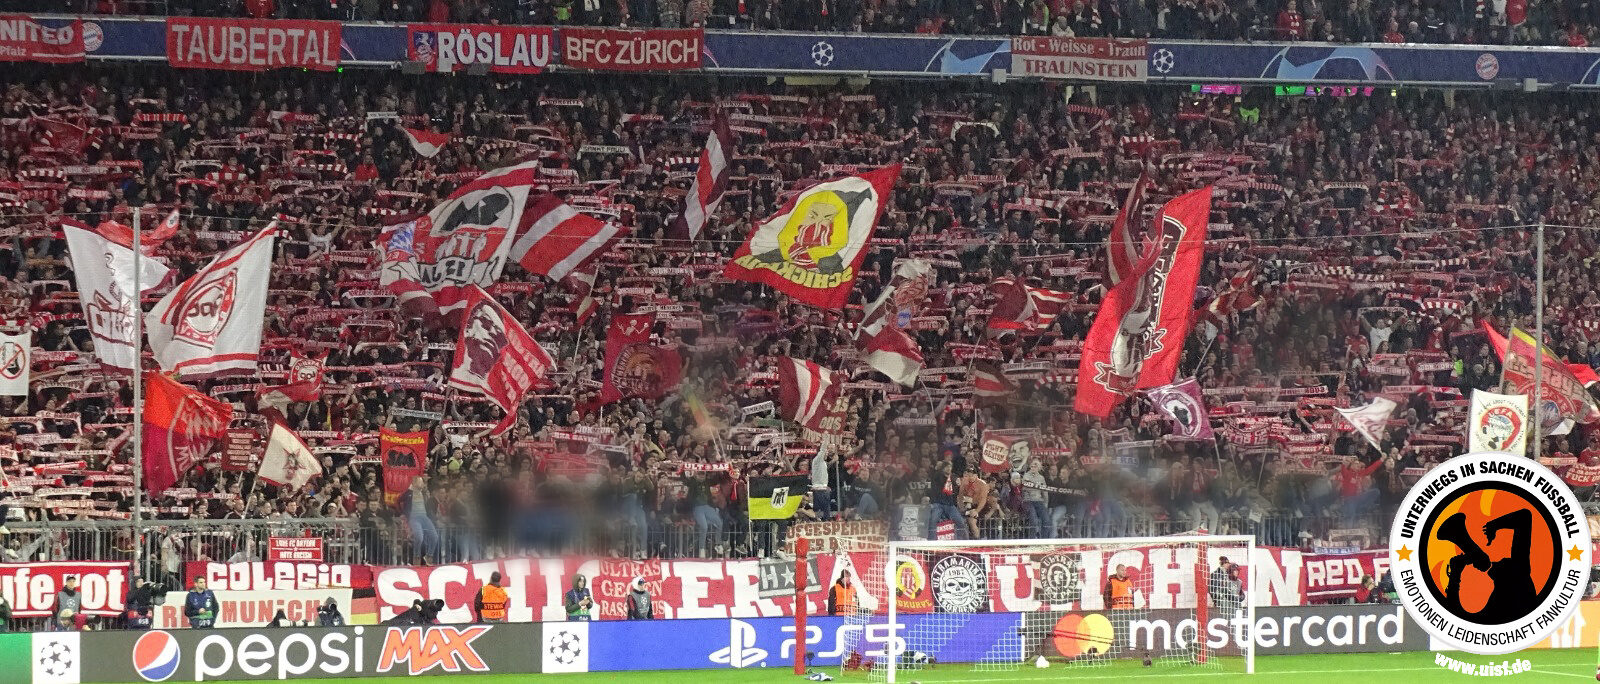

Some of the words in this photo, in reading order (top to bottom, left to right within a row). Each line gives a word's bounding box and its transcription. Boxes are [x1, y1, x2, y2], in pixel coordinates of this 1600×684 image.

[172, 25, 338, 66] TAUBERTAL
[437, 28, 549, 71] RÖSLAU
[566, 37, 611, 63] BFC
[615, 37, 699, 65] ZÜRICH
[1013, 38, 1037, 51] Rot
[1049, 39, 1095, 55] Weisse
[1023, 58, 1137, 77] TRAUNSTEIN
[600, 560, 661, 578] ULTRAS
[948, 569, 965, 577] 1987
[781, 623, 906, 659] PS5
[1130, 606, 1403, 651] mastercard
[195, 626, 364, 682] pepsi
[376, 624, 494, 676] MAX
